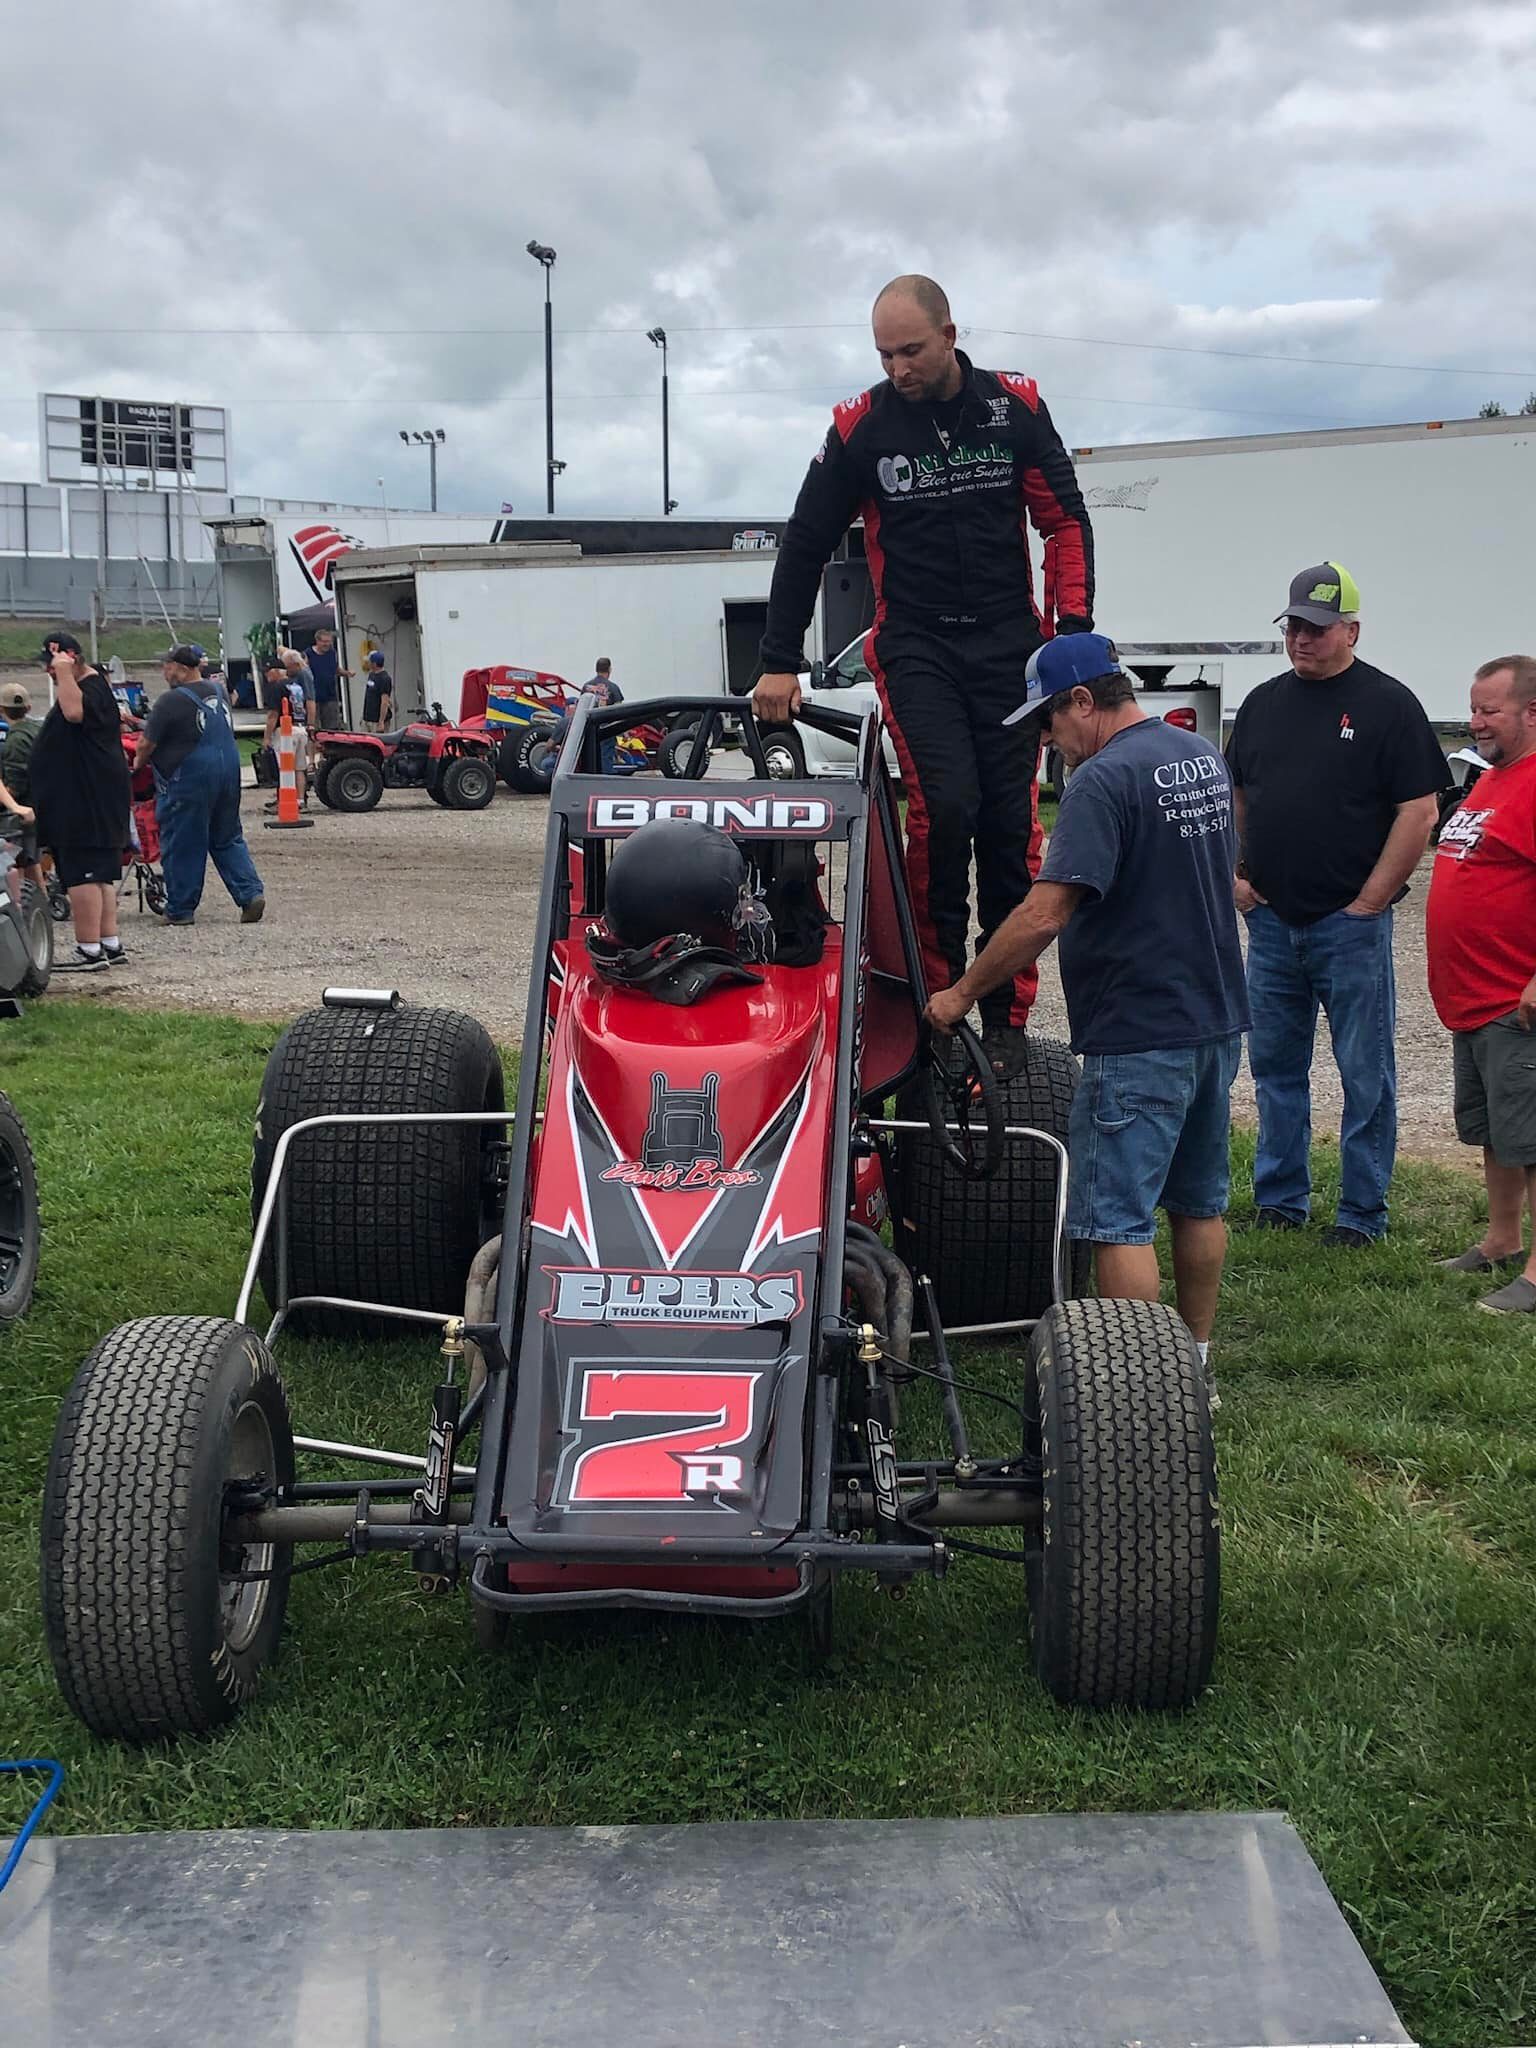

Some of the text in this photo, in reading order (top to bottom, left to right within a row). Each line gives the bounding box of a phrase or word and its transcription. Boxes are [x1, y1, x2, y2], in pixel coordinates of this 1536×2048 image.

[973, 464, 1014, 481] Supply
[1153, 754, 1222, 788] CZOER
[596, 799, 826, 828] BOND
[602, 1159, 758, 1188] Davis Bros.
[553, 1271, 796, 1323] ELPERS
[611, 1306, 749, 1320] TRUCK EQUIPMENT
